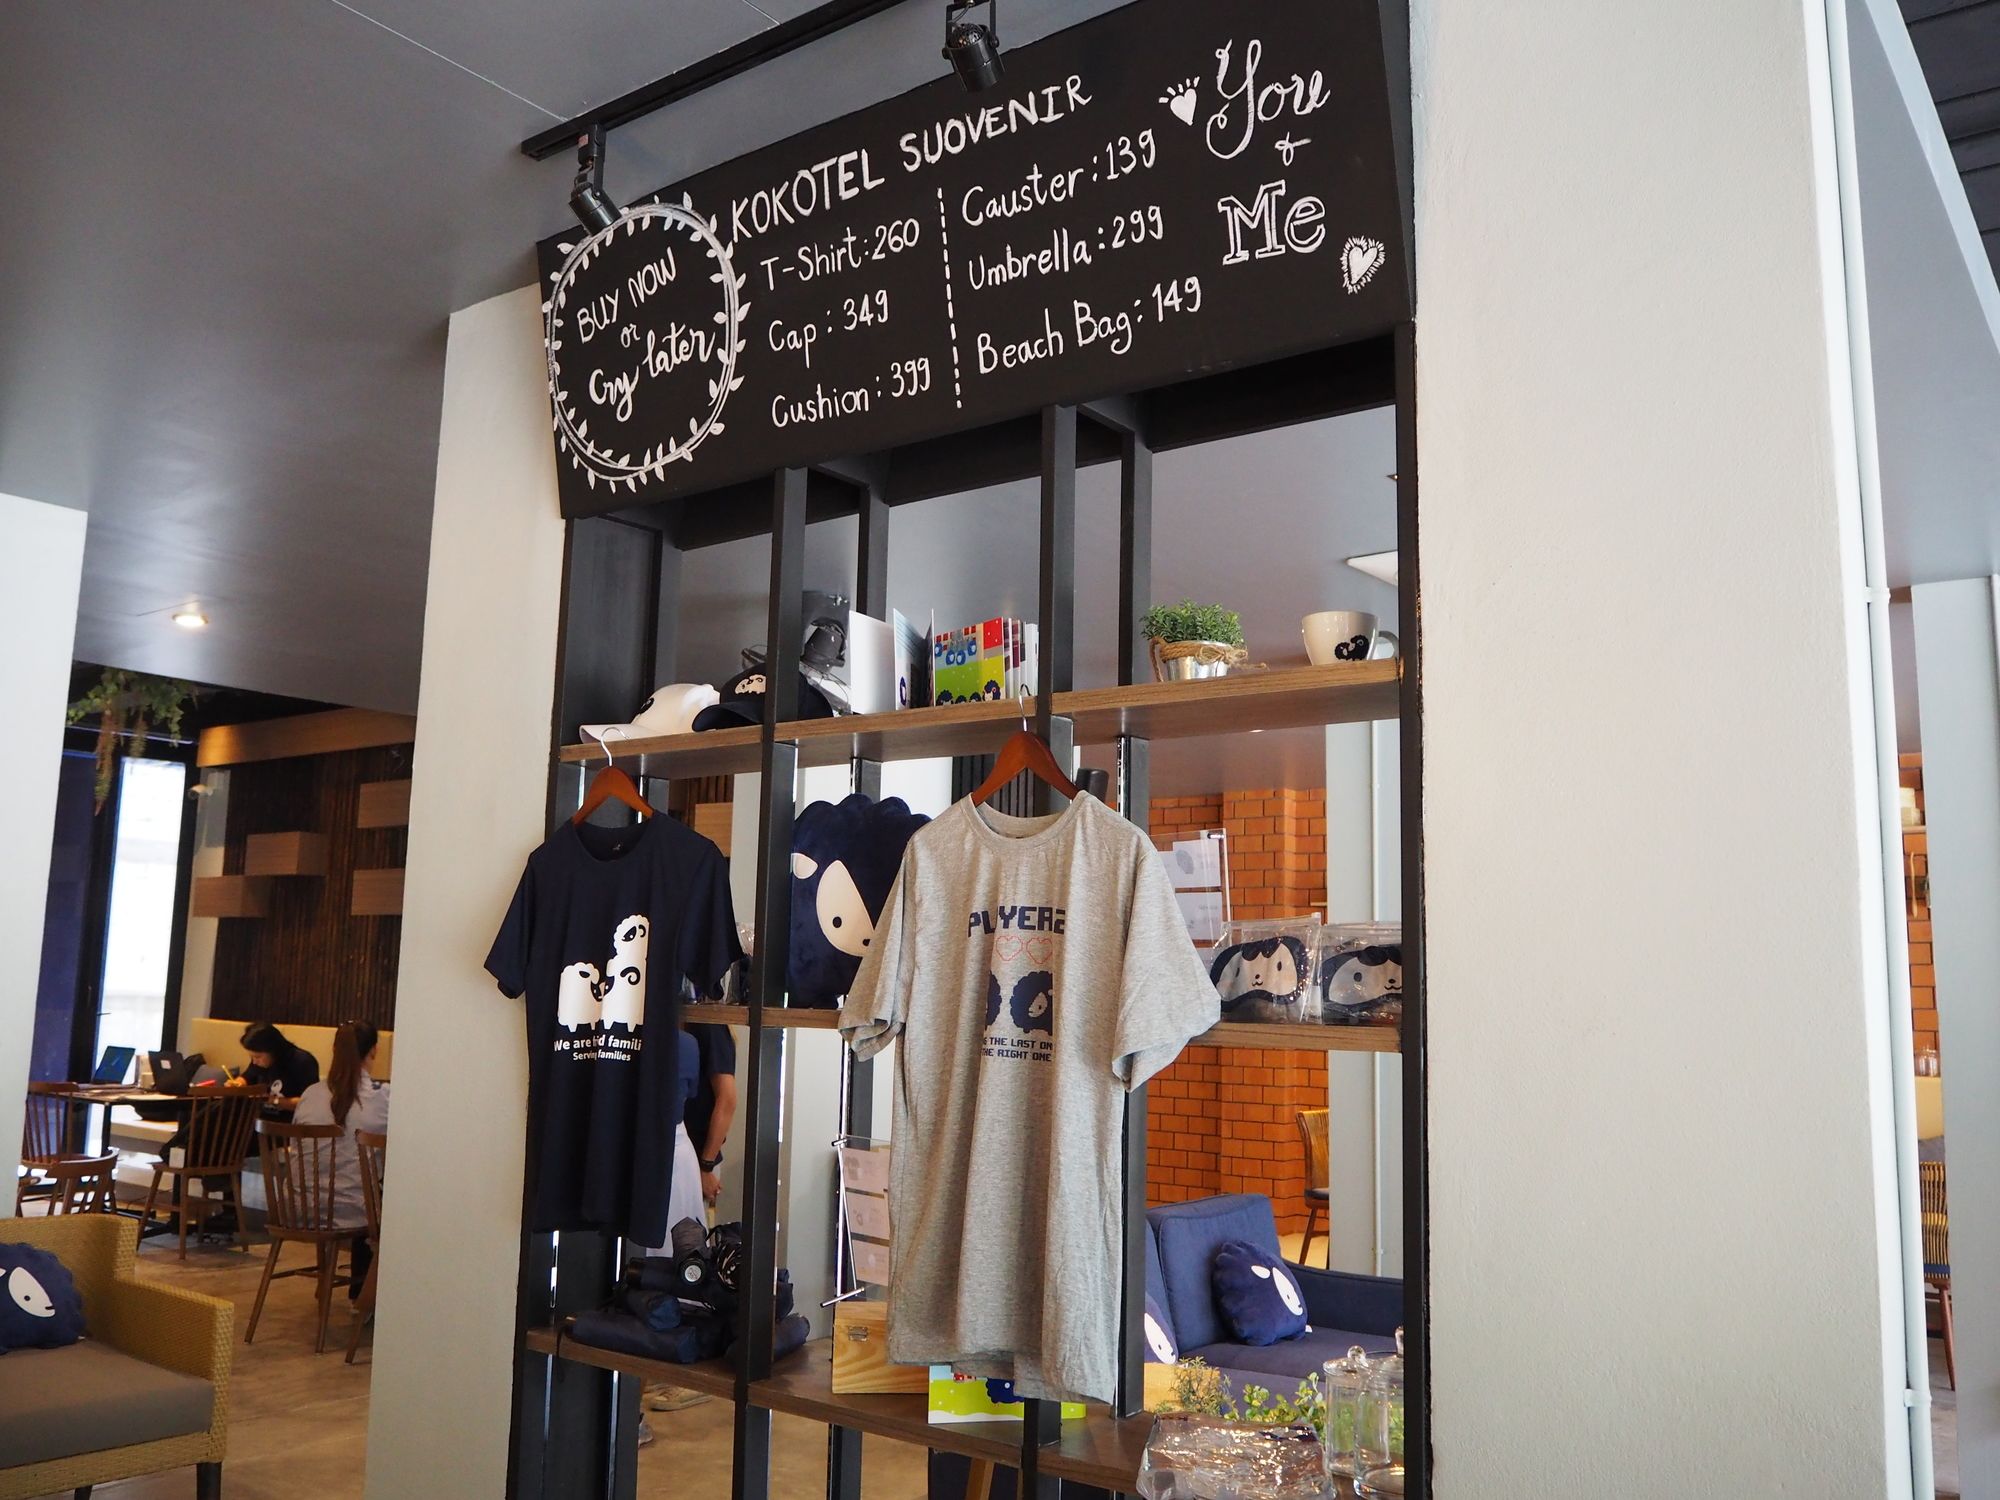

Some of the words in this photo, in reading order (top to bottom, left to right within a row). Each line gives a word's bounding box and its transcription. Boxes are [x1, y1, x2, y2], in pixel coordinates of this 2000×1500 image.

[1206, 39, 1330, 159] You
[733, 148, 886, 244] KOKOTEL
[899, 75, 1093, 173] SUOVENIR
[1218, 179, 1326, 266] Me
[576, 288, 619, 344] BUY
[628, 246, 677, 308] NOW
[620, 322, 641, 348] or
[977, 308, 1064, 375] Beach
[1151, 276, 1202, 323] 149
[589, 365, 640, 423] Cry
[642, 321, 717, 378] later
[554, 1039, 570, 1052] We
[573, 1038, 591, 1049] are
[608, 1035, 642, 1052] famili
[597, 1049, 631, 1061] families
[989, 1037, 1008, 1046] THE
[1010, 1038, 1037, 1049] LAST
[1040, 1041, 1054, 1051] ON
[997, 1049, 1030, 1060] RIGHT
[1032, 1052, 1053, 1062] ONE
